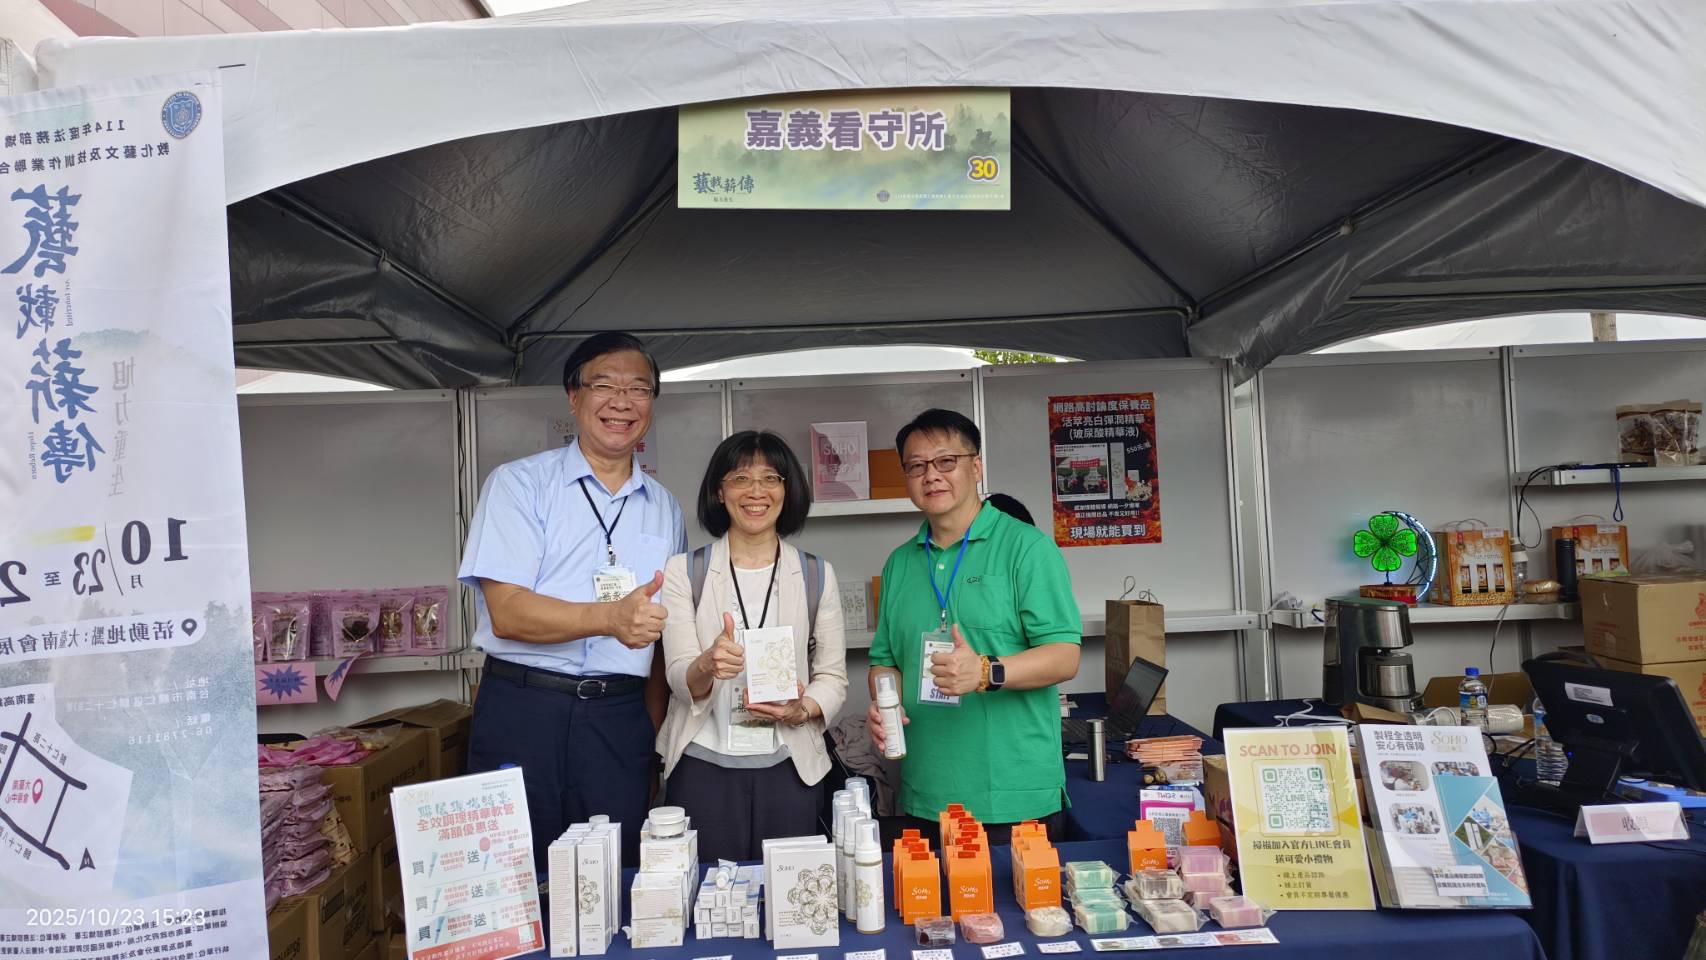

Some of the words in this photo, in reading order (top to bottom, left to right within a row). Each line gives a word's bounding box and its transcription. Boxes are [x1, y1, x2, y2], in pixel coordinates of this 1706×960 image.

[746, 109, 945, 149] 嘉義看守所
[971, 158, 997, 180] 30
[1070, 524, 1146, 540] 現場就能買到
[1374, 730, 1423, 741] 製程全透明
[1240, 745, 1278, 757] SCAN
[1280, 744, 1300, 756] TO
[1304, 743, 1336, 756] JOIN
[438, 818, 499, 842] 滿額優惠送
[467, 850, 480, 864] 送
[412, 861, 425, 876] 買
[471, 885, 484, 899] 送
[474, 913, 487, 928] 送
[418, 925, 431, 942] 買
